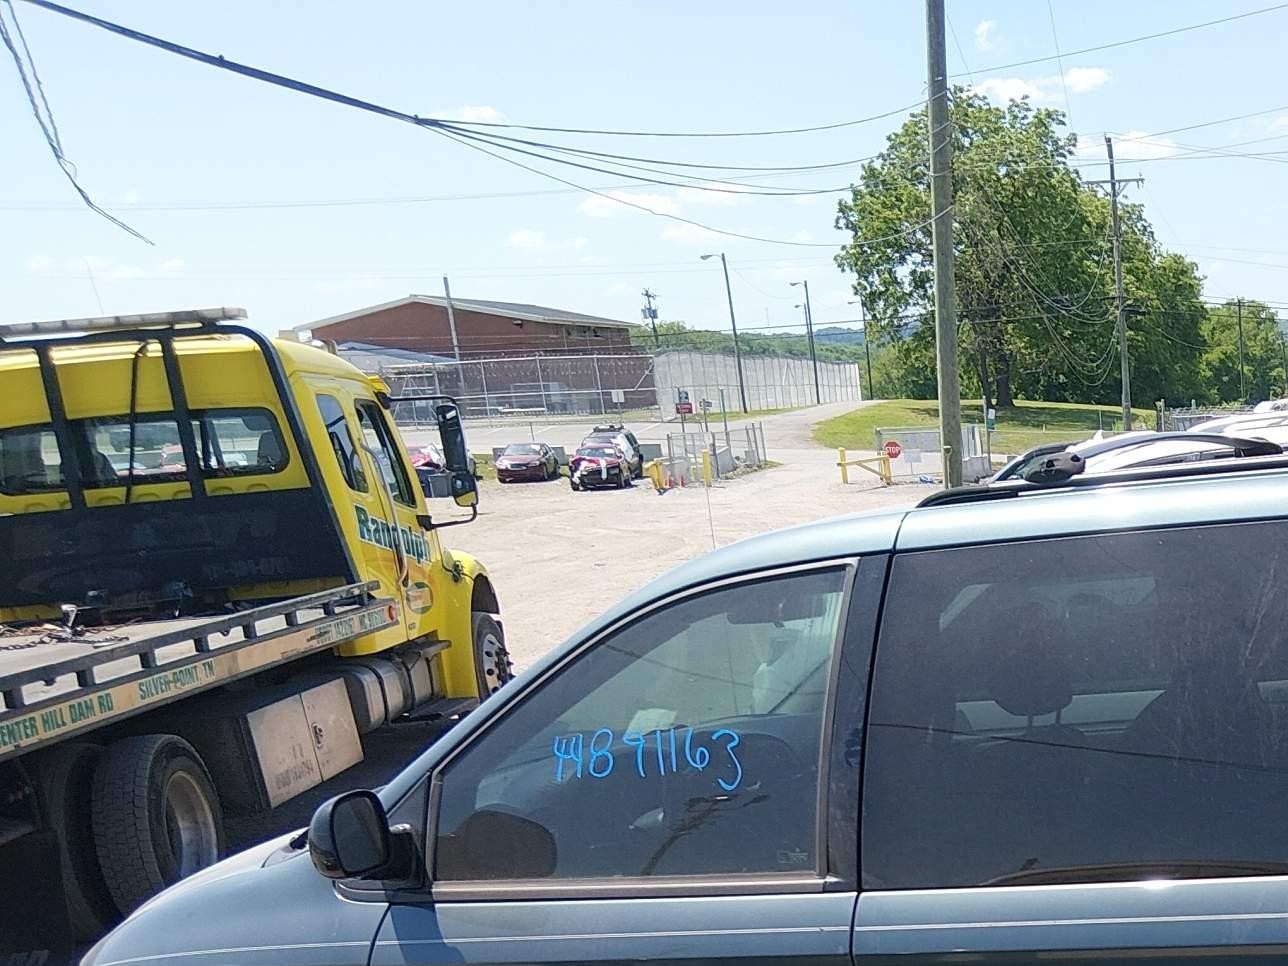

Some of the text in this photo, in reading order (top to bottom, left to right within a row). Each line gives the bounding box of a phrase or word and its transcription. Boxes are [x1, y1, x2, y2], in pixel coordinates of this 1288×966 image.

[886, 446, 900, 454] STOP
[354, 504, 432, 567] Randolph
[0, 716, 39, 748] ENTER
[41, 707, 67, 732] HILL
[69, 698, 96, 724] DAM
[97, 692, 114, 714] RD
[138, 674, 171, 700] SILVER
[202, 660, 216, 679] TN
[554, 728, 743, 791] 44891163
